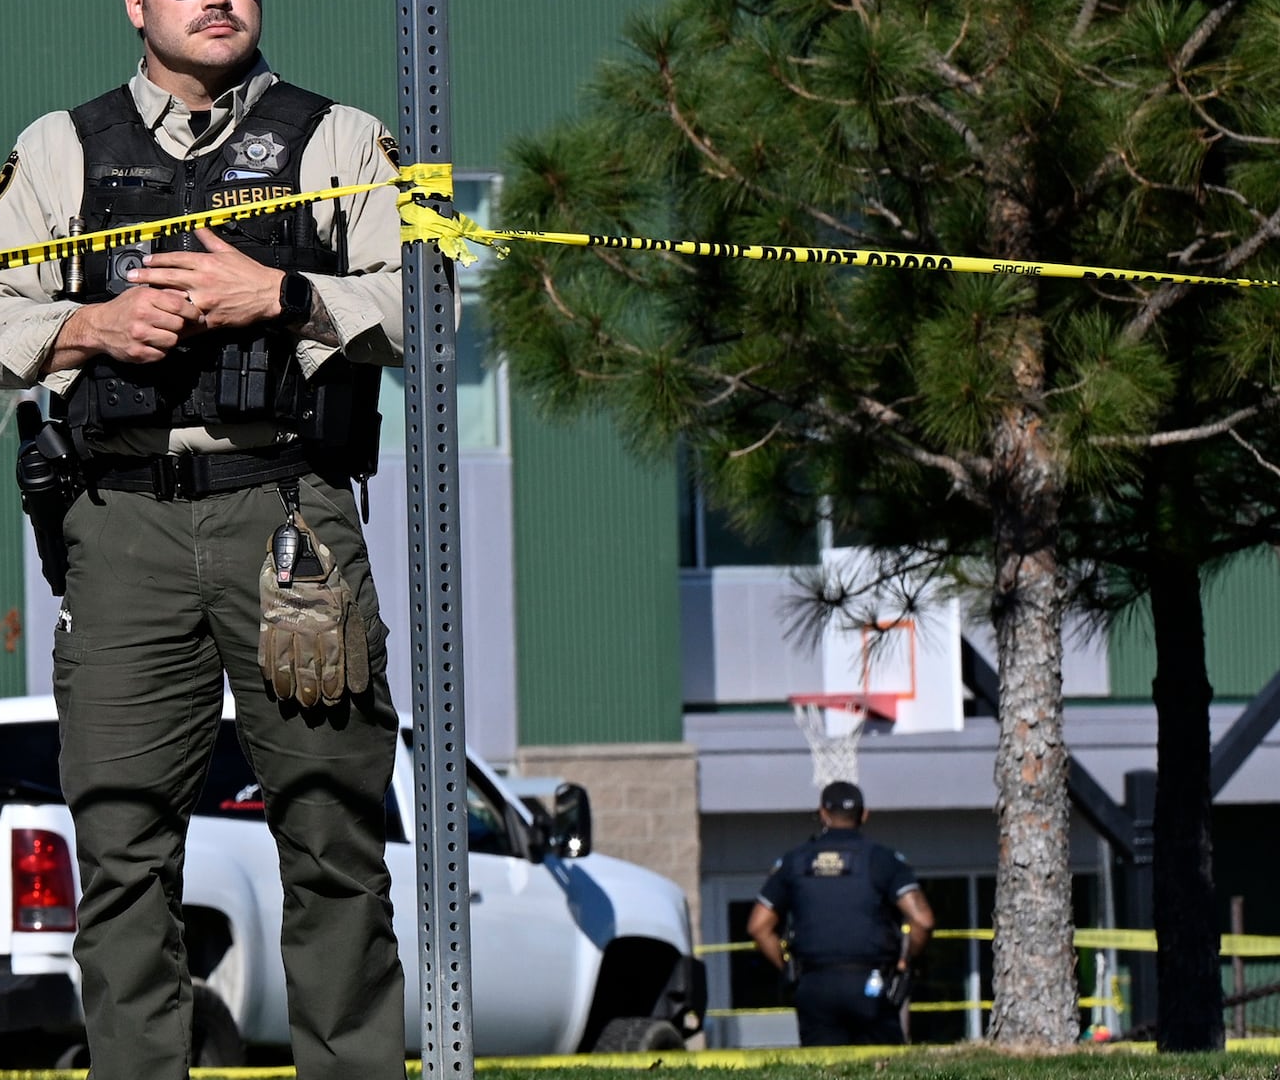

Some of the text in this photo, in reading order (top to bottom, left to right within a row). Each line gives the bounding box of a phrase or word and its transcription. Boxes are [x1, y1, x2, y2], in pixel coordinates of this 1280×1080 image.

[111, 168, 152, 177] PALMER
[211, 186, 292, 208] SHERIFF
[992, 263, 1043, 275] SIRCHIE
